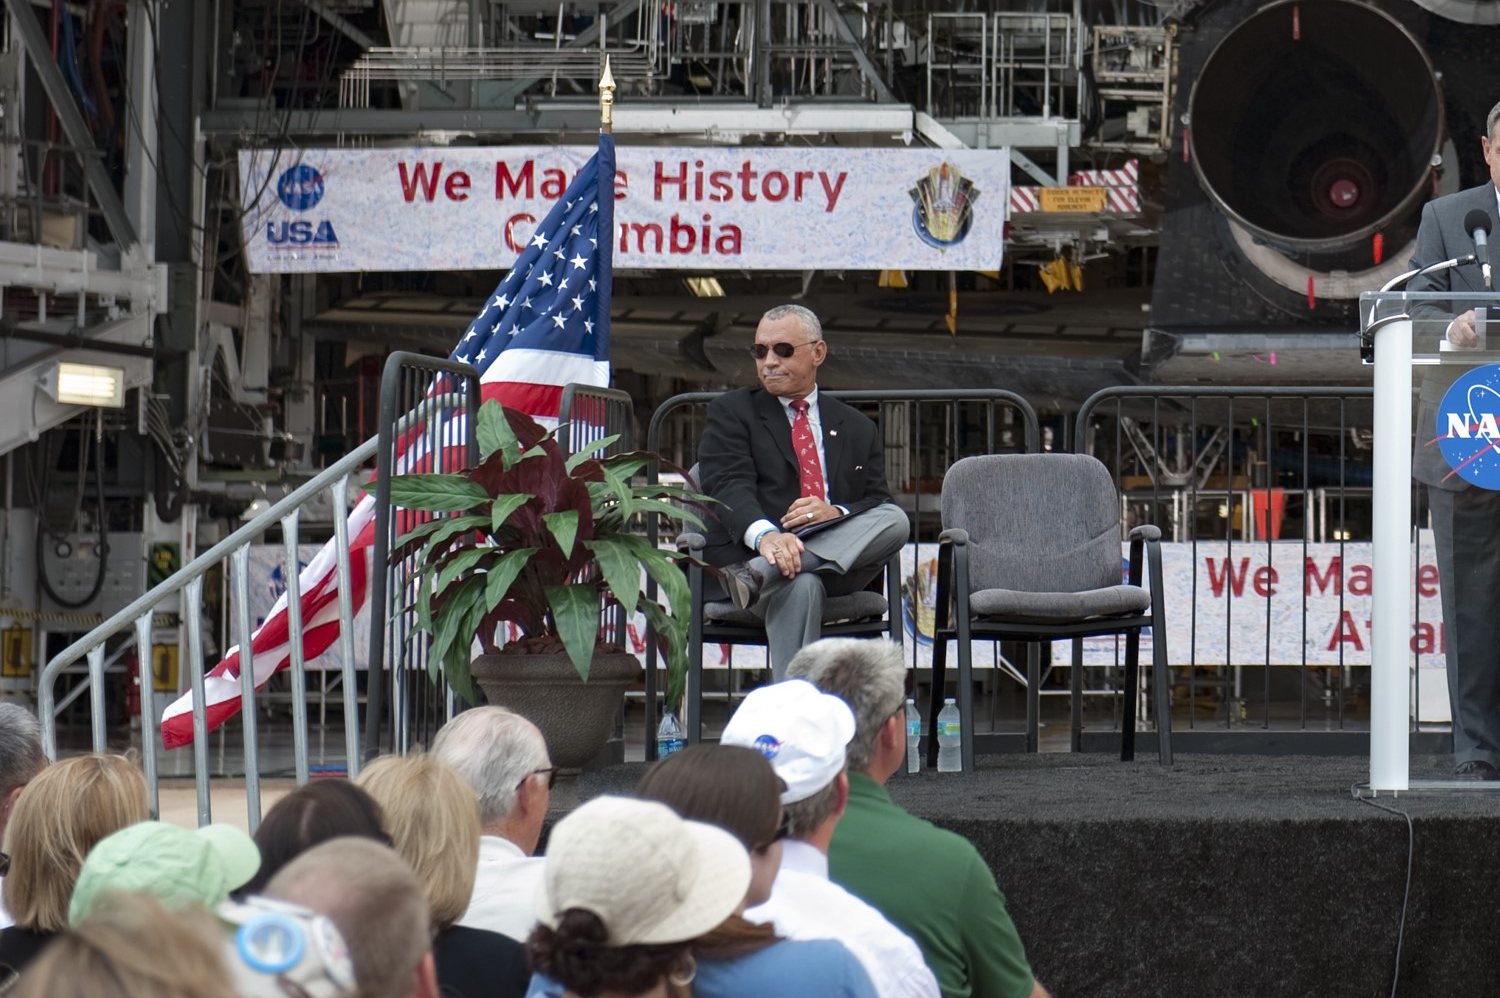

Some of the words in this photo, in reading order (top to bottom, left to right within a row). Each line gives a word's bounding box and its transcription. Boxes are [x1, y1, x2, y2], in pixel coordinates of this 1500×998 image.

[398, 161, 471, 202] We
[495, 160, 628, 200] Mae
[653, 159, 848, 213] History
[266, 220, 339, 243] USA
[504, 212, 742, 255] Cmbia
[1205, 557, 1279, 598] We
[1305, 556, 1439, 597] Mae
